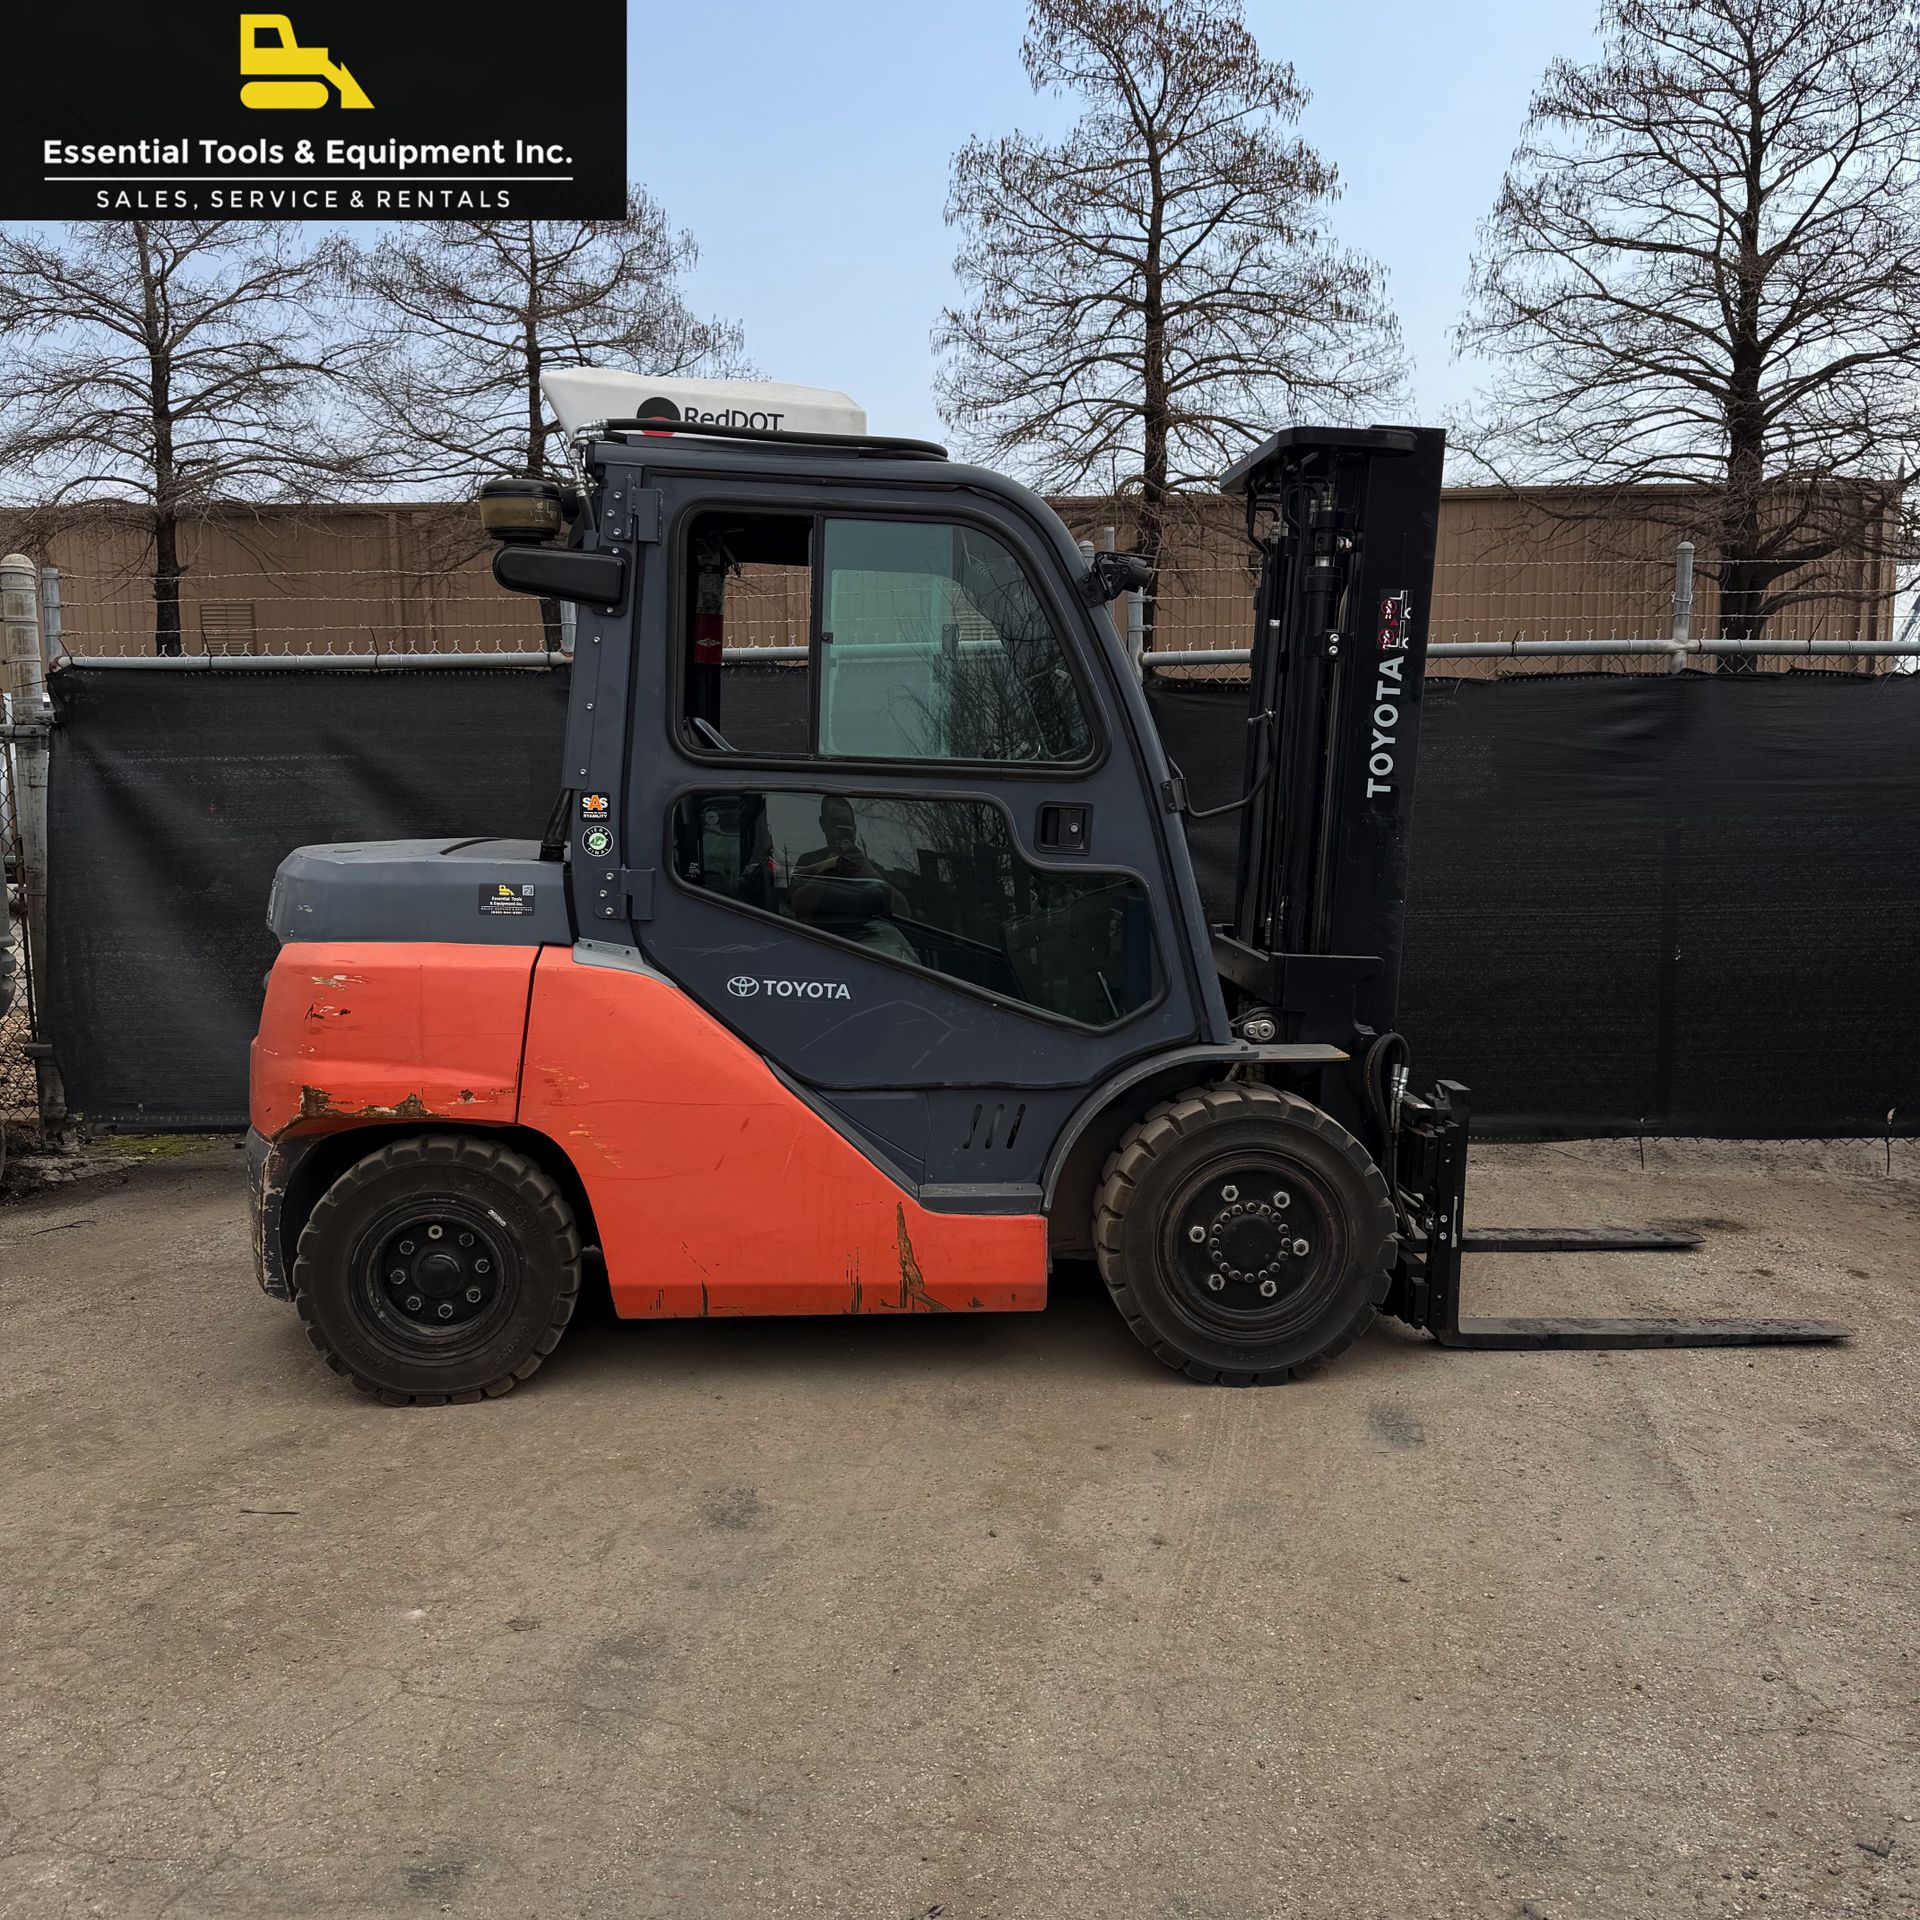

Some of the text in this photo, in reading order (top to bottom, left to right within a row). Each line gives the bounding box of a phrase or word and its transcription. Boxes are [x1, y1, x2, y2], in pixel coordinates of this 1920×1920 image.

[1366, 655, 1404, 798] TOYOTA
[582, 795, 608, 810] SAS
[587, 847, 609, 855] FINAL
[763, 980, 851, 1000] TOYOTA
